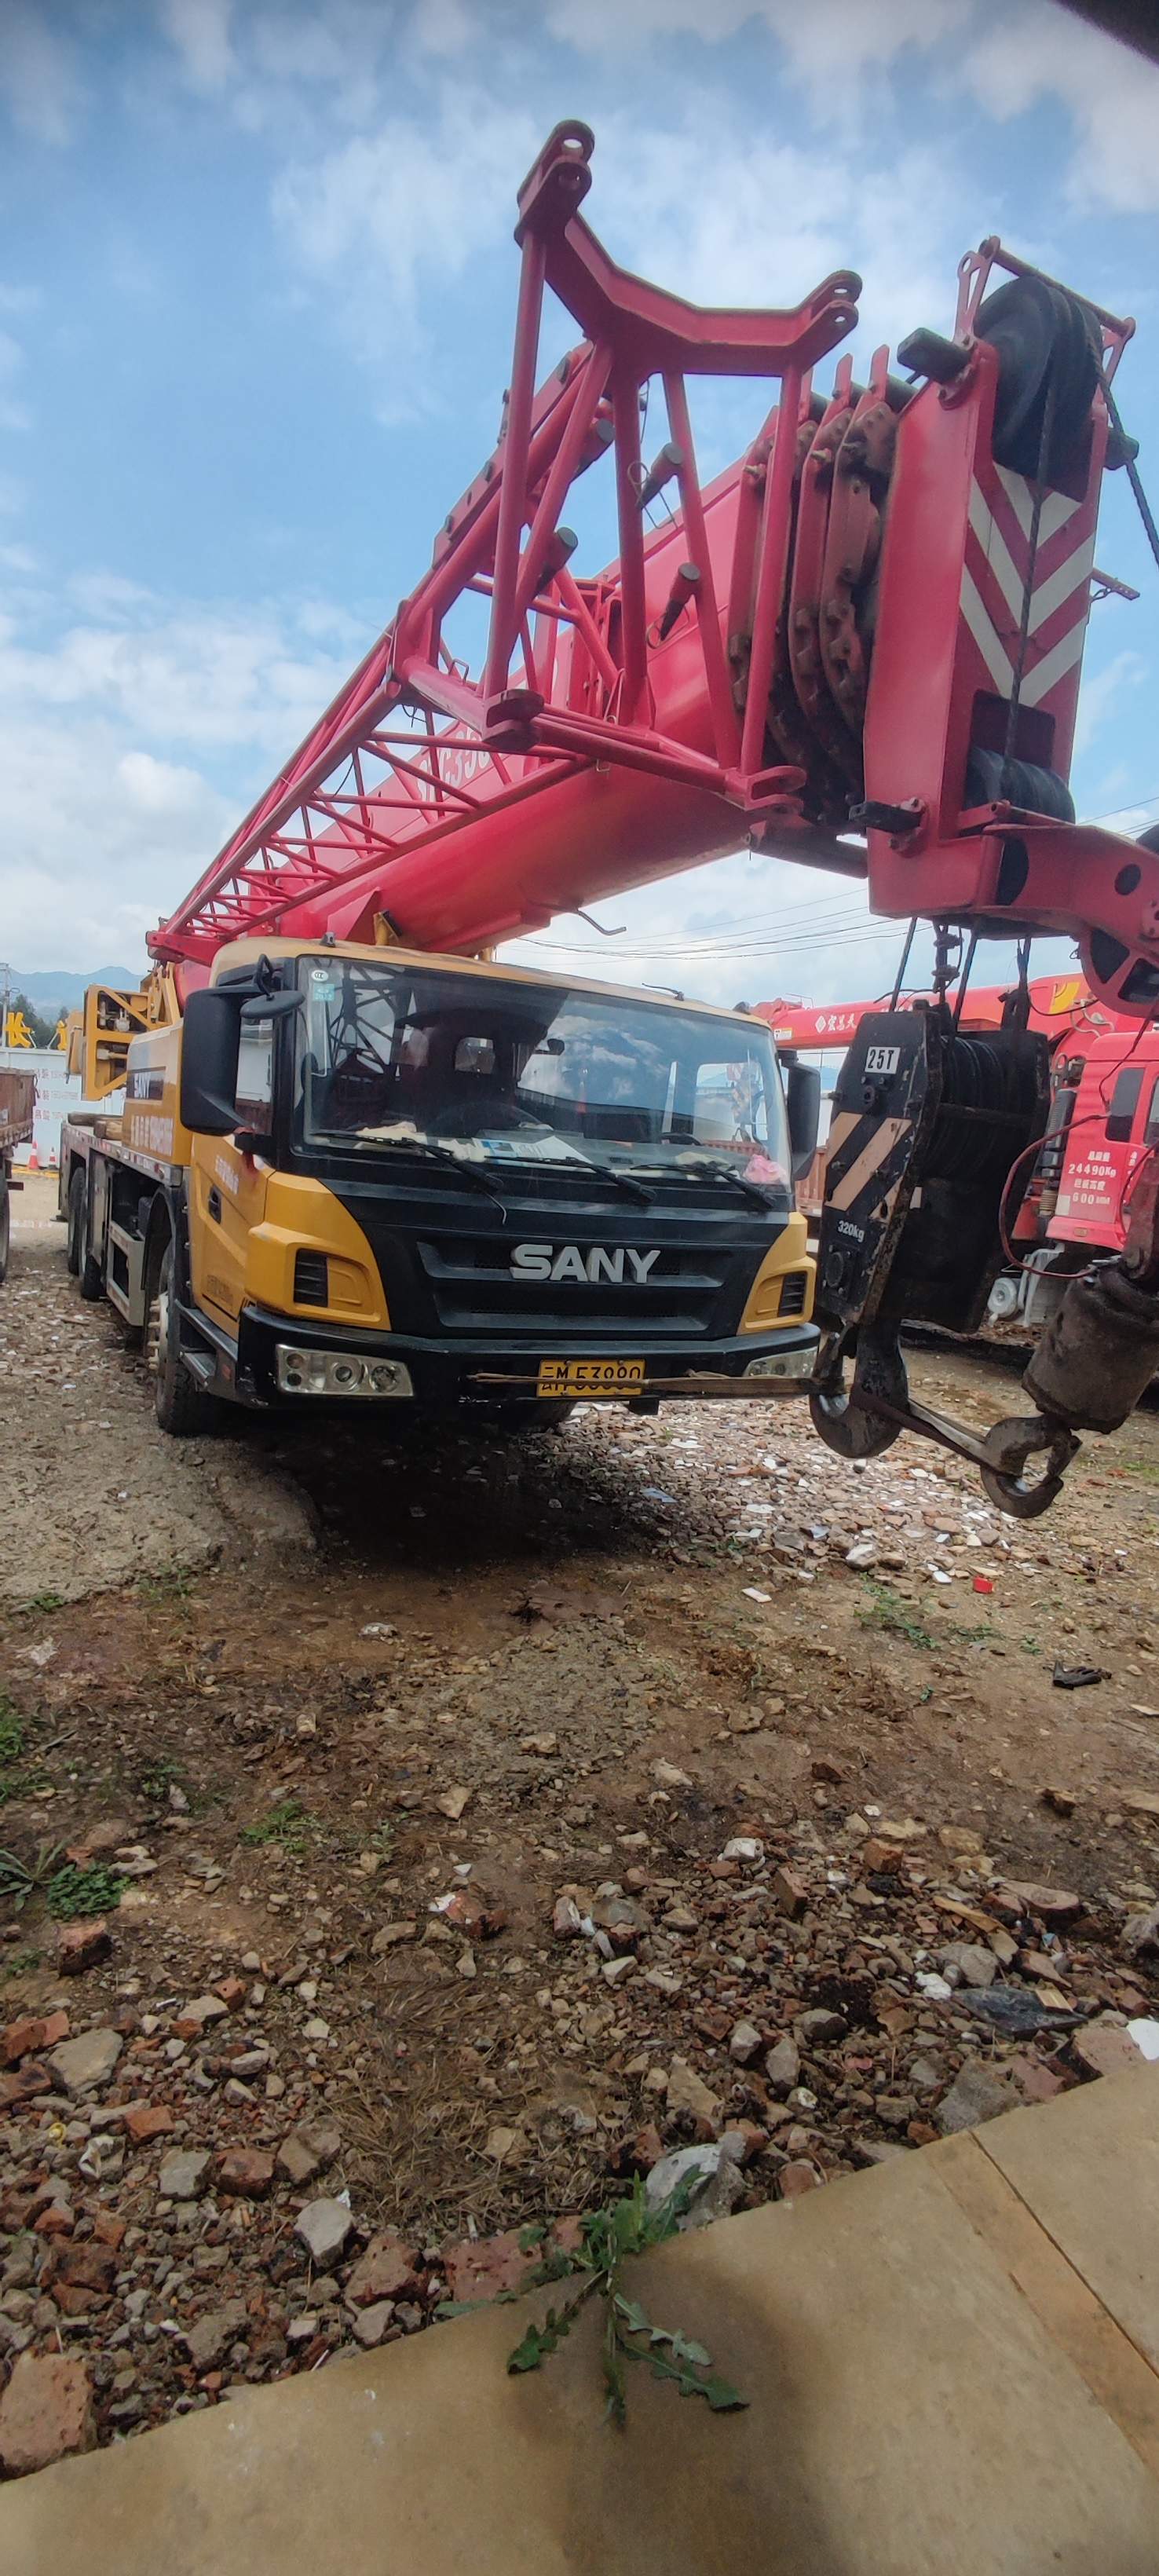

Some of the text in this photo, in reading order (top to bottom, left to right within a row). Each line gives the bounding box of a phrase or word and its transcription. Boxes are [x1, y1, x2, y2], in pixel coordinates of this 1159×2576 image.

[868, 1048, 895, 1070] 25T
[838, 1220, 865, 1242] 320kg
[510, 1243, 661, 1284] SANY
